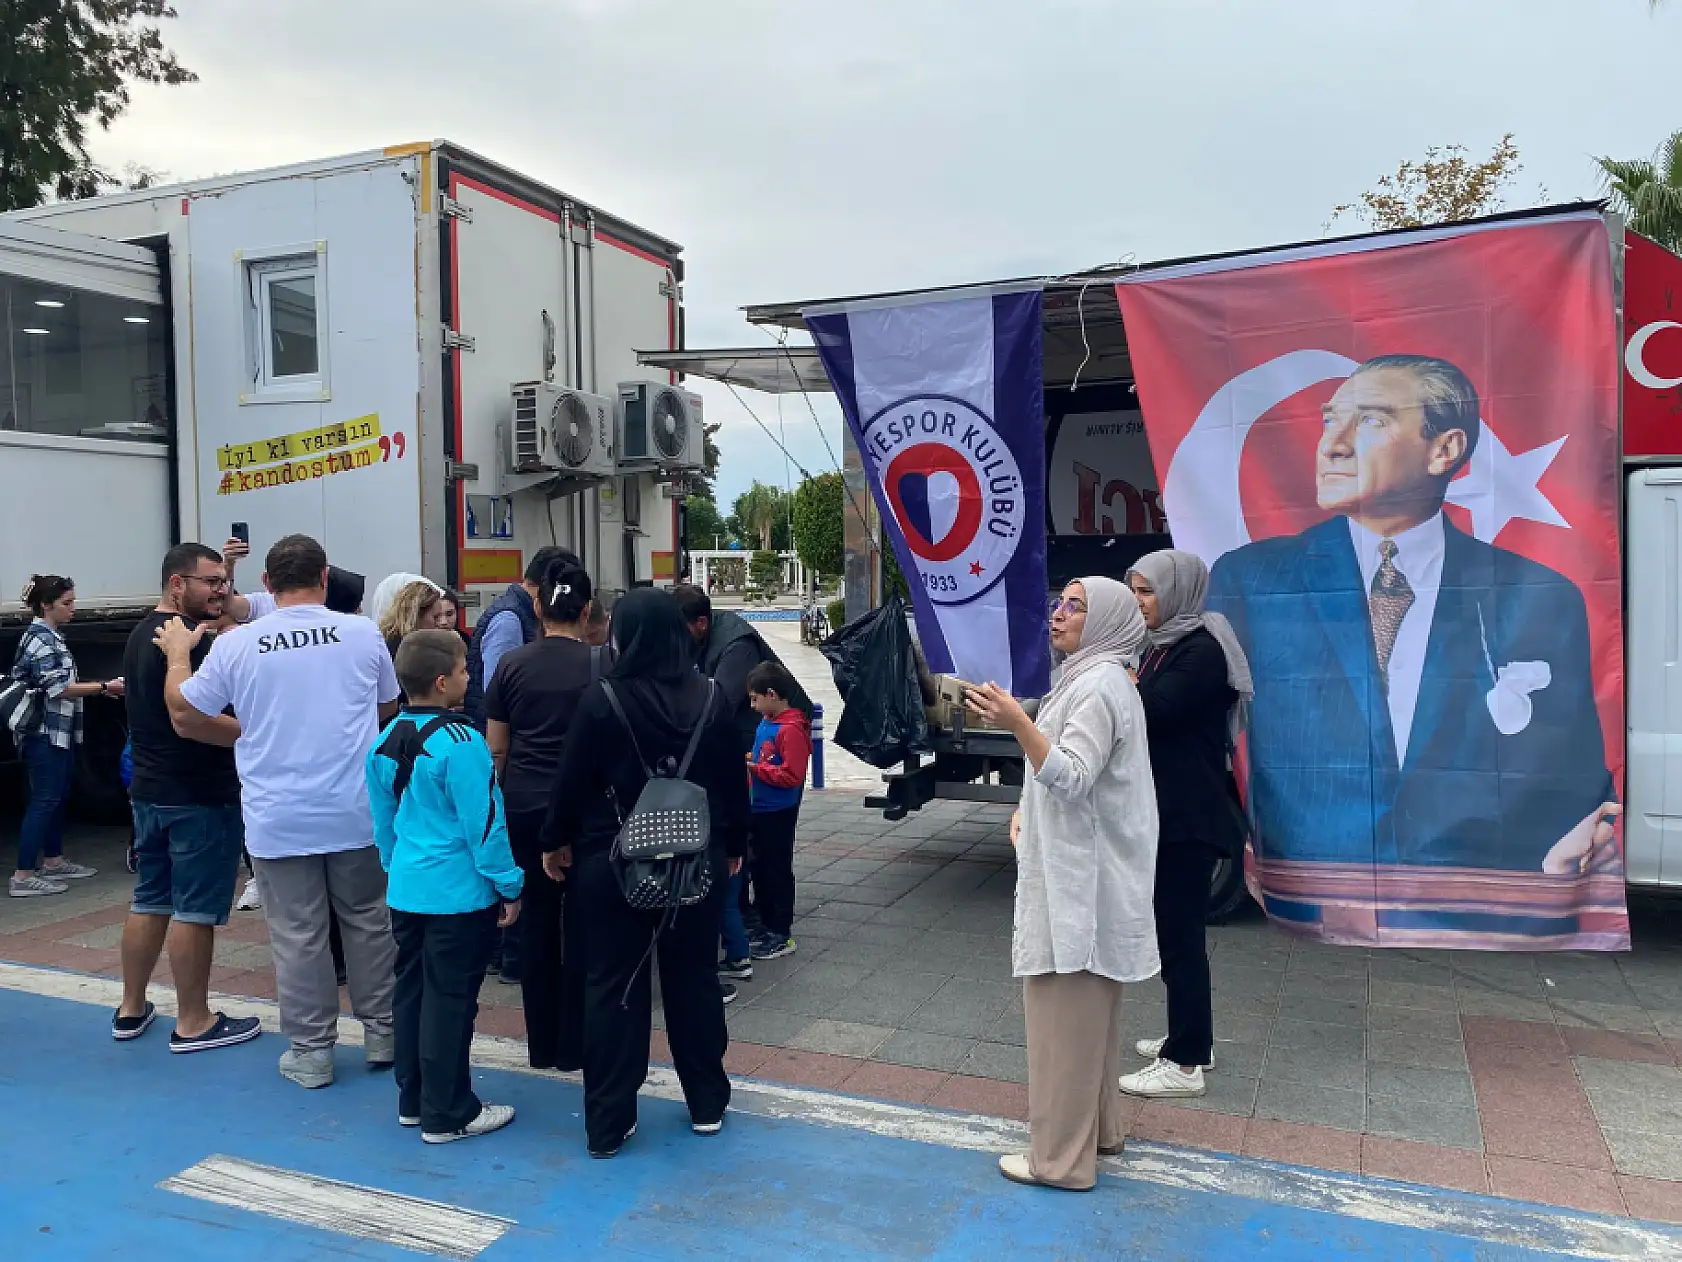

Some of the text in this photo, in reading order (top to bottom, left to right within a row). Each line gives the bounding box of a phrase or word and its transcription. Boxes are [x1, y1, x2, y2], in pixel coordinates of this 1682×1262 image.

[266, 439, 290, 458] ki
[301, 422, 373, 451] varsın
[960, 424, 1018, 538] KULÜBÜ
[921, 573, 958, 591] 1933
[257, 626, 341, 653] SADIK
